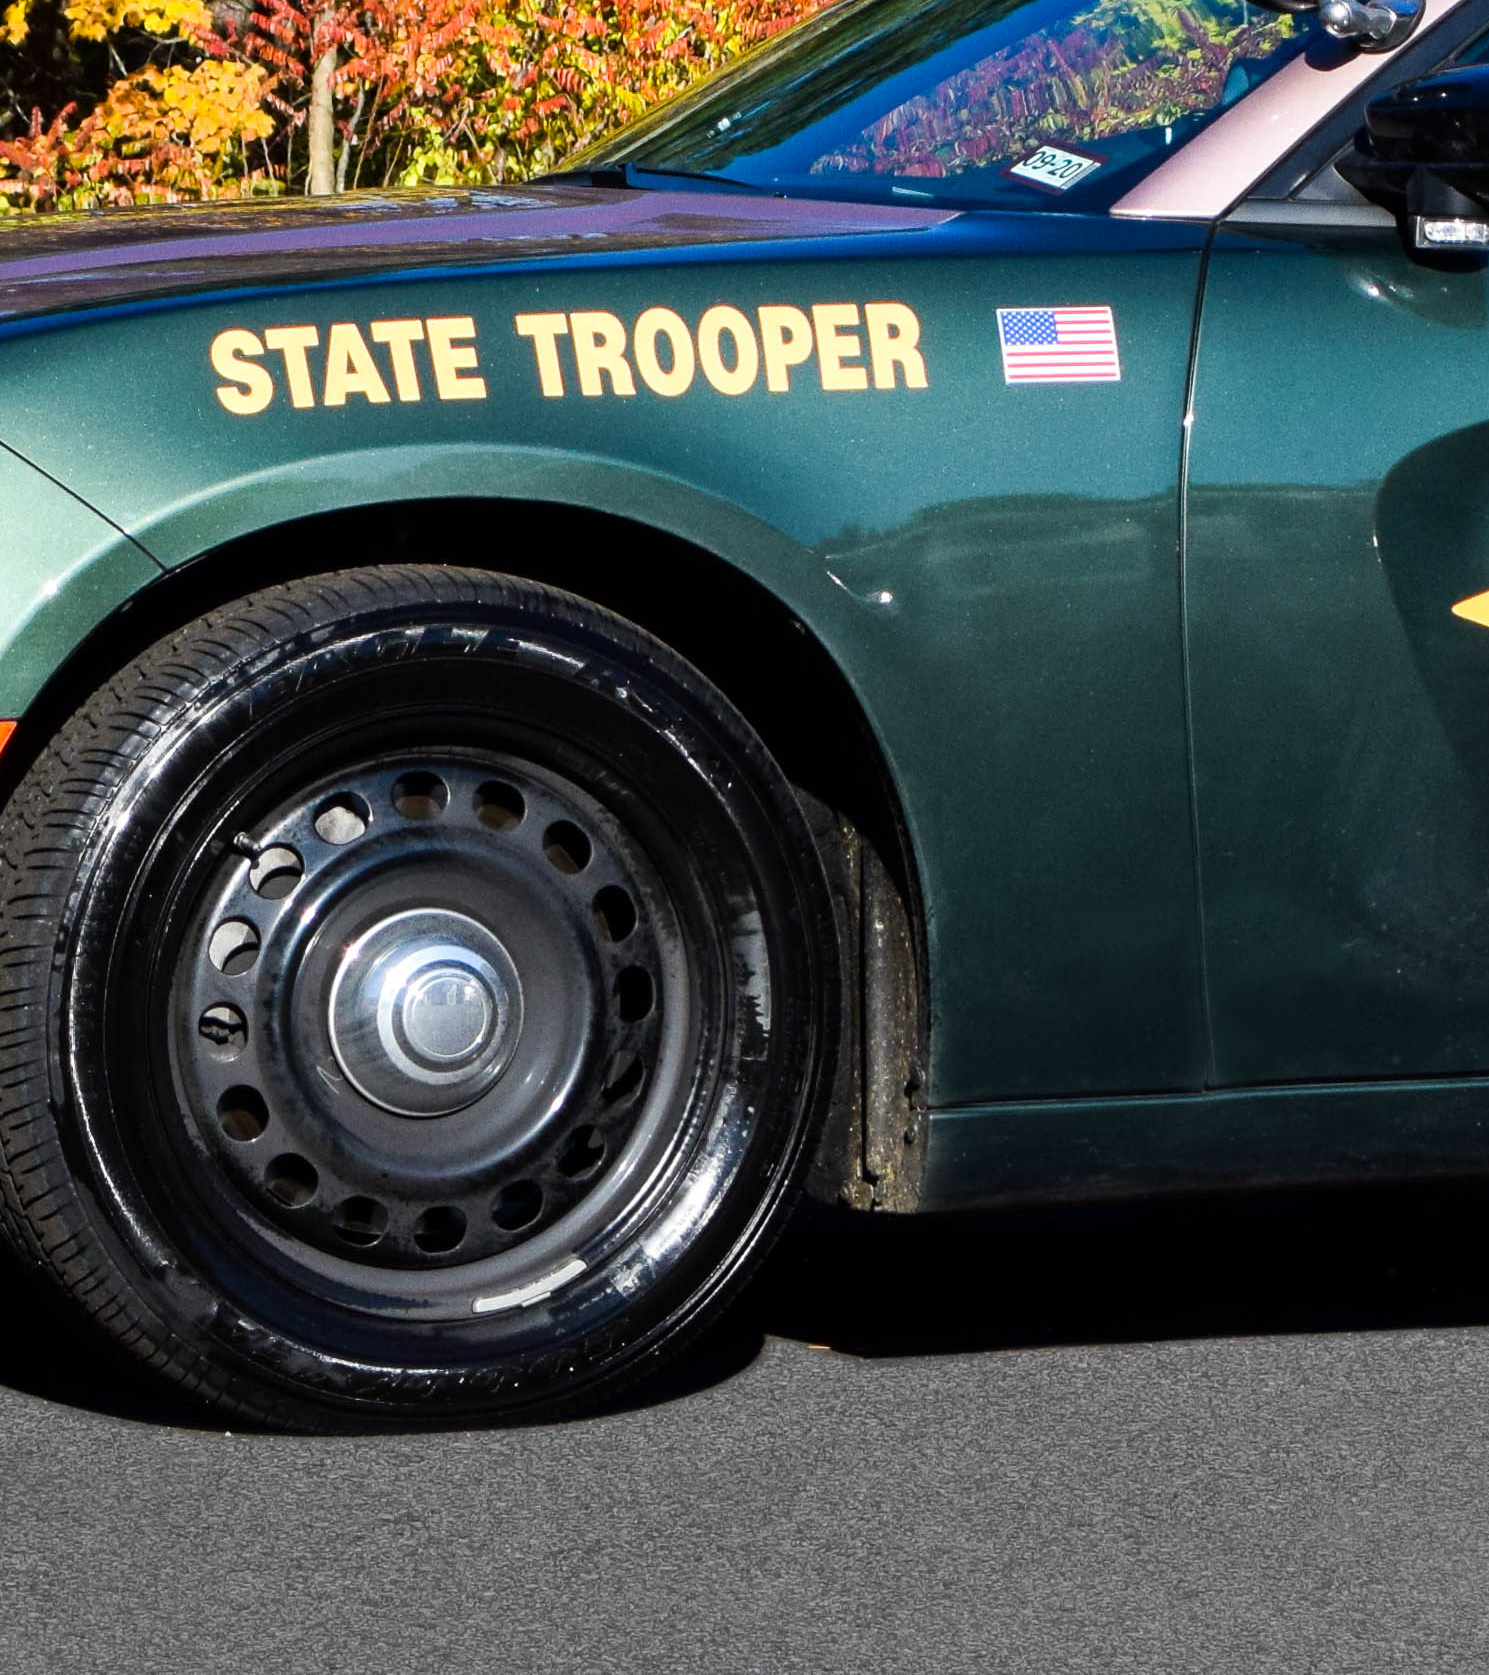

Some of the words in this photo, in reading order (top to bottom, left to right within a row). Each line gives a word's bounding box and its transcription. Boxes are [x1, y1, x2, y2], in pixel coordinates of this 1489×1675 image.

[1022, 151, 1083, 179] 09-20
[208, 314, 489, 417] STATE
[513, 302, 930, 400] TROOPER
